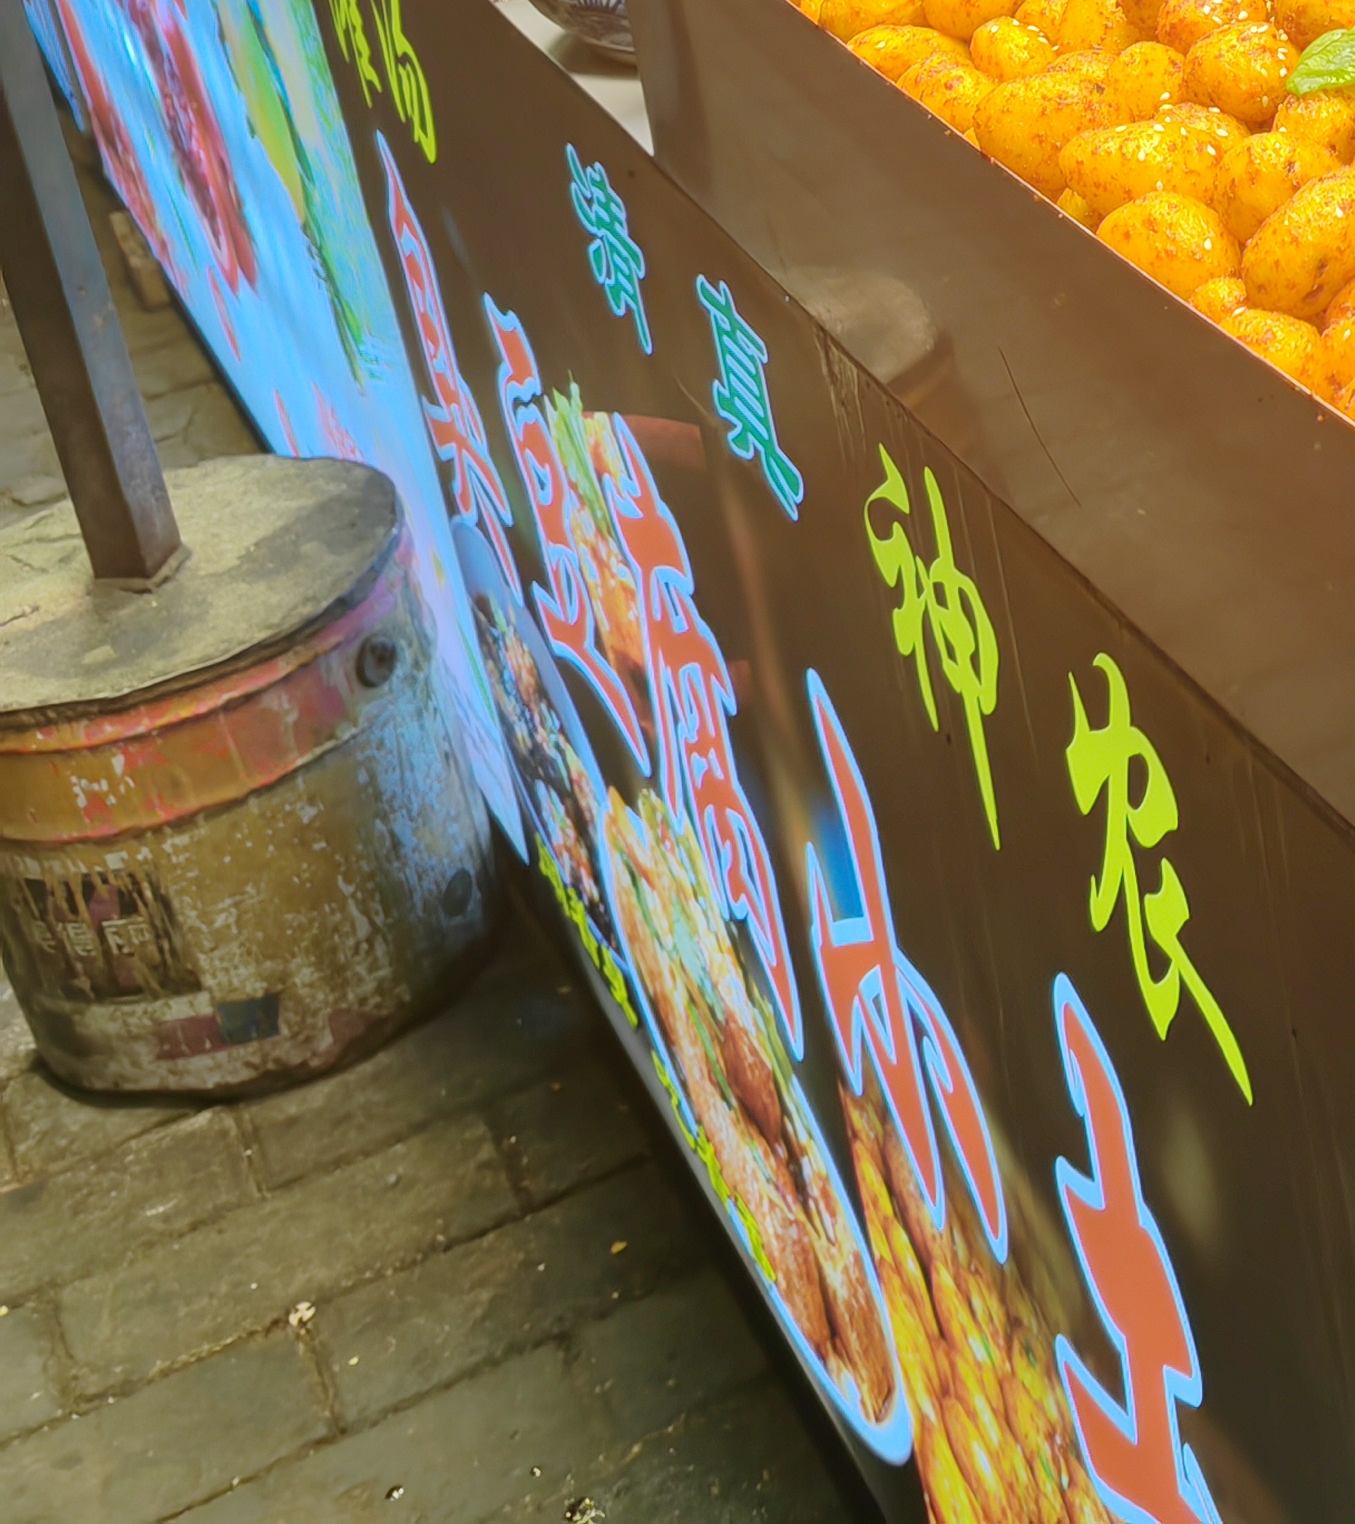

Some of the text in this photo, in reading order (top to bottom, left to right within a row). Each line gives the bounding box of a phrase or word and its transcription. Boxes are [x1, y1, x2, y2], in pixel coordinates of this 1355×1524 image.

[374, 129, 804, 1060] 臭豆腐
[565, 141, 804, 522] 清真
[865, 443, 1253, 1105] 神农
